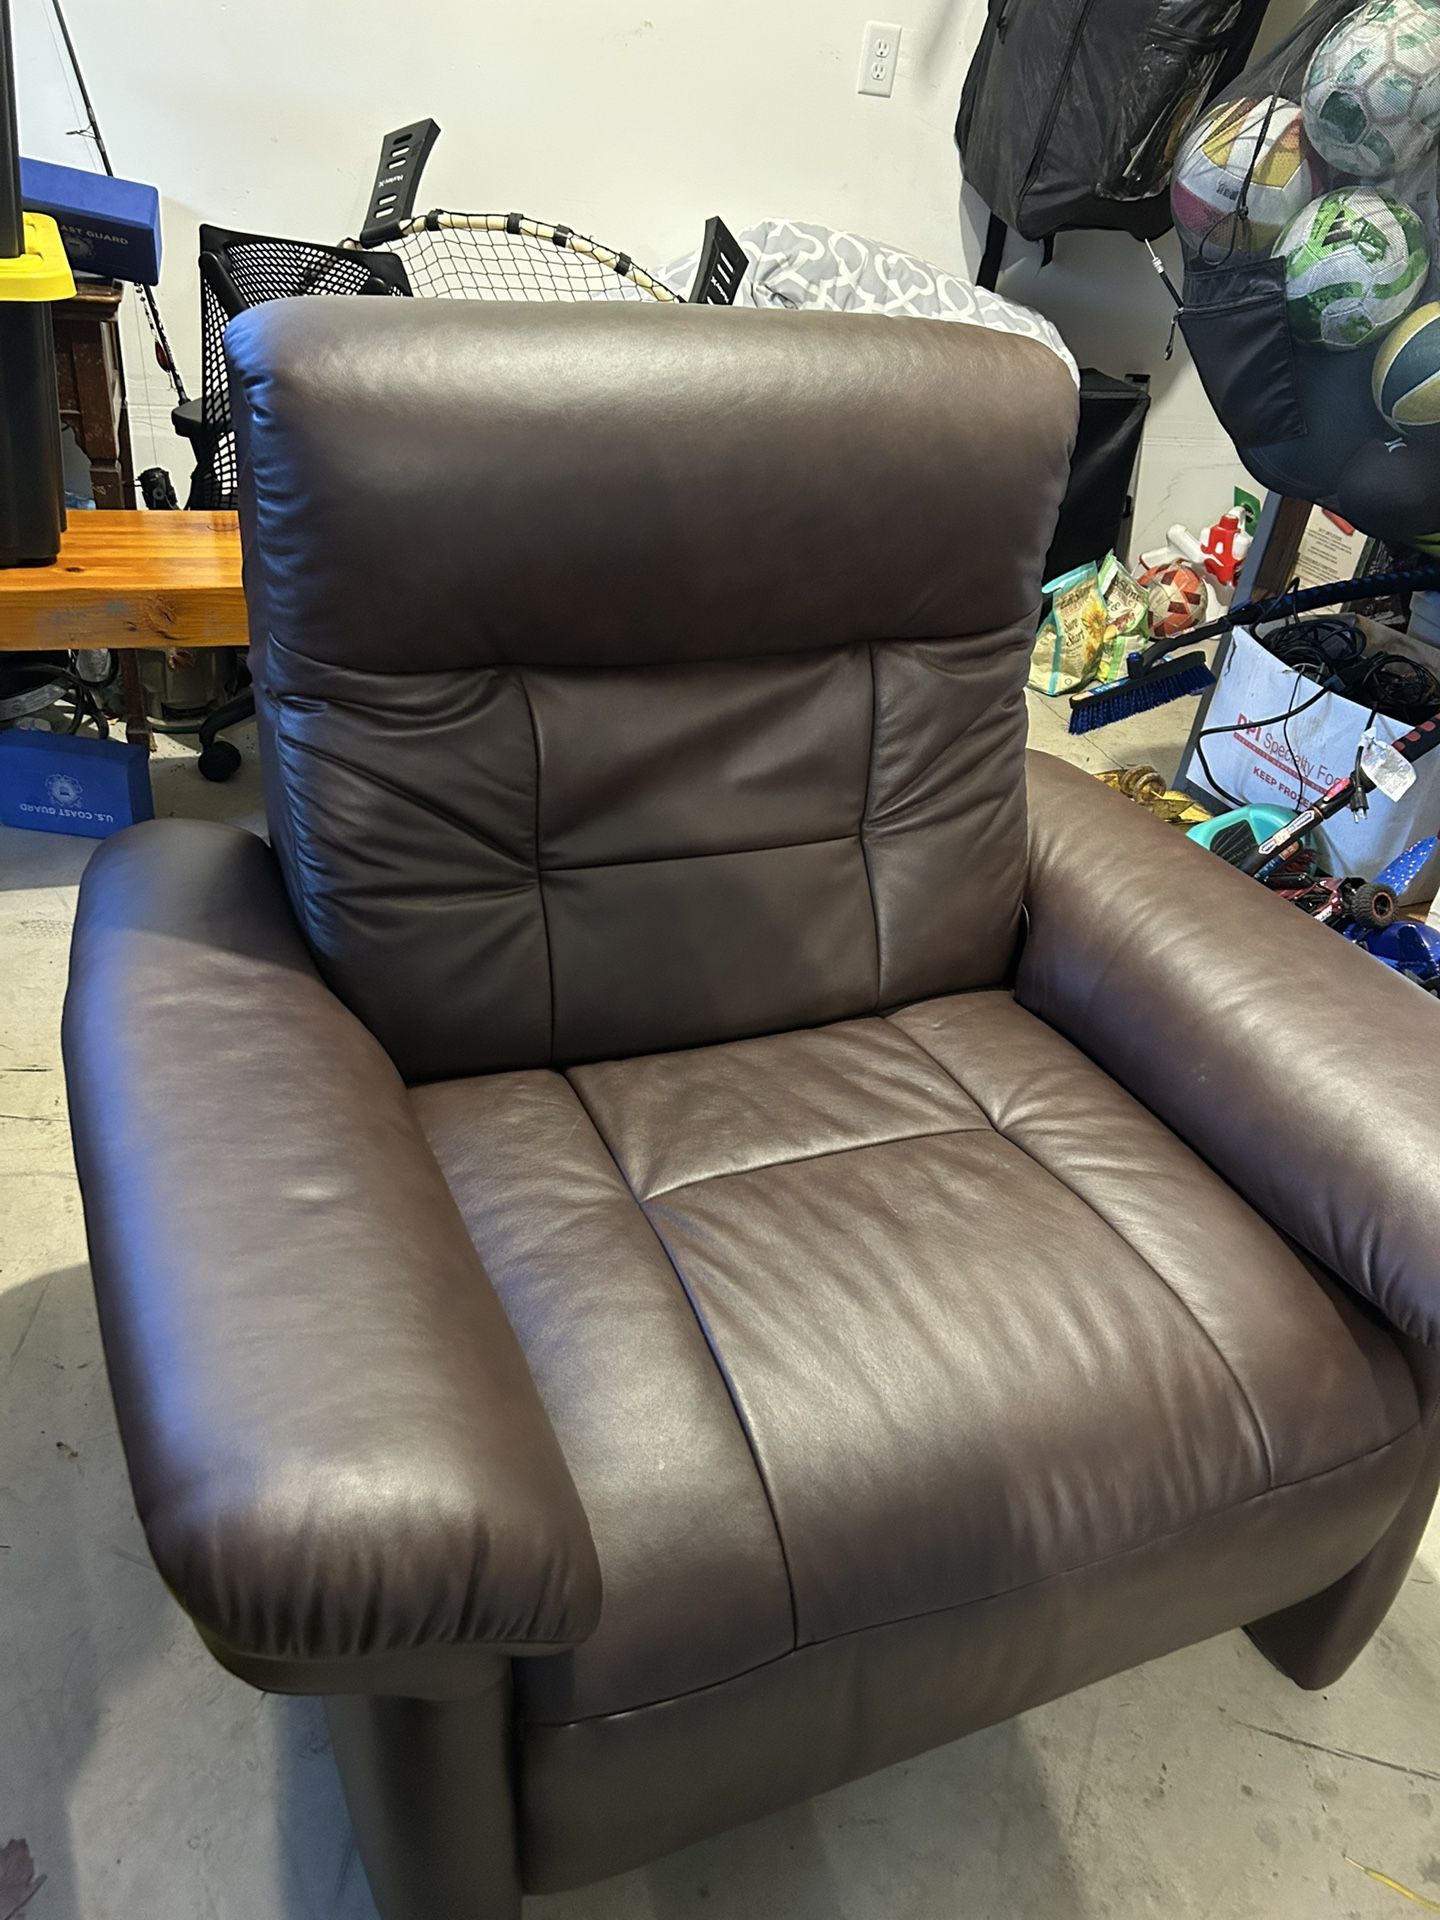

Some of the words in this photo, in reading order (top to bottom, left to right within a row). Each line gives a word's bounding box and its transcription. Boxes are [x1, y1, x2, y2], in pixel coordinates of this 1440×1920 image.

[61, 224, 82, 234] AST
[86, 230, 129, 245] GUARD
[1263, 732, 1315, 777] Specialty
[1253, 766, 1278, 786] KEEP
[1278, 783, 1314, 808] FROE
[20, 803, 56, 815] GUARD
[59, 808, 93, 820] COAST
[94, 813, 114, 823] U.S.
